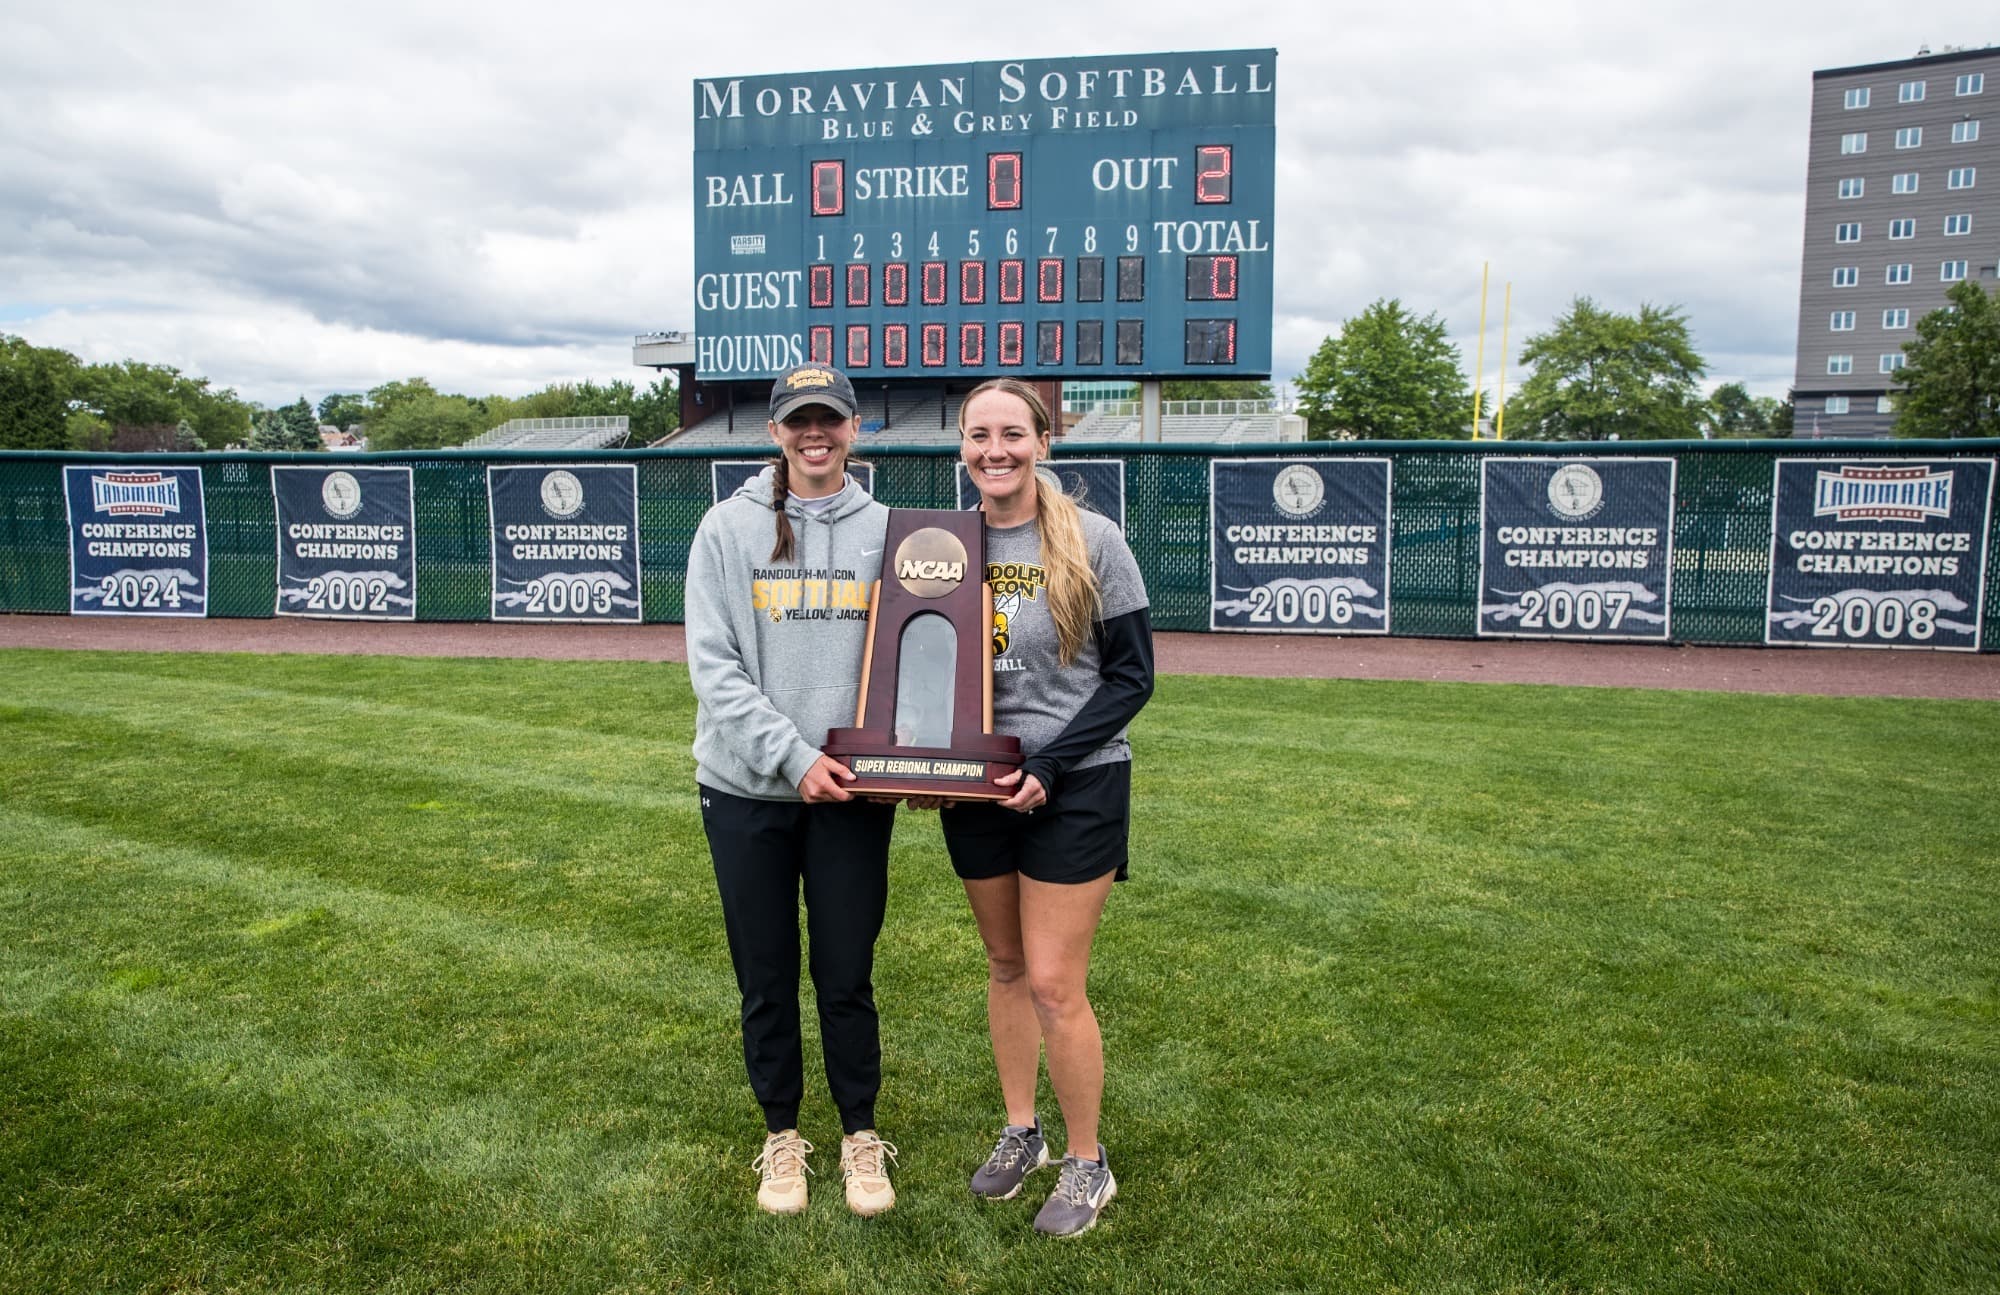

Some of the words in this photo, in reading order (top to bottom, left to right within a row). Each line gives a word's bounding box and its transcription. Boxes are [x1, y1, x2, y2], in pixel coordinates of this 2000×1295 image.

[699, 78, 965, 119] MORAVIAN
[1000, 63, 1272, 103] SOFTBALL
[822, 118, 893, 139] BLUE
[911, 112, 933, 135] &
[954, 110, 1032, 133] GREY
[1051, 107, 1138, 129] FIELD
[706, 173, 793, 207] BALL
[812, 161, 843, 214] 0
[855, 165, 969, 200] STRIKE
[989, 154, 1020, 208] 0
[1092, 157, 1178, 191] OUT
[1198, 146, 1230, 202] 2
[733, 236, 764, 246] VARSITY
[818, 235, 826, 260] 1
[853, 234, 864, 259] 2
[891, 232, 902, 258] 3
[928, 231, 940, 256] 4
[968, 230, 980, 256] 5
[1006, 228, 1018, 255] 6
[1046, 227, 1058, 253] 7
[1084, 226, 1096, 252] 8
[1126, 225, 1138, 252] 9
[1154, 220, 1268, 253] TOTAL
[697, 271, 801, 310] GUEST
[811, 265, 832, 307] 0
[848, 264, 870, 305] 0
[885, 263, 907, 305] 0
[923, 262, 946, 304] 0
[961, 261, 984, 303] 0
[1000, 260, 1022, 302] 0
[1040, 260, 1062, 301] 0
[1212, 256, 1236, 299] 0
[697, 333, 804, 373] HOUNDS
[848, 326, 869, 366] 0
[885, 325, 907, 366] 0
[922, 324, 945, 366] 0
[961, 323, 984, 365] 0
[1000, 323, 1022, 365] 0
[95, 482, 177, 506] LANDMARK
[1819, 479, 1949, 509] LANDMARK
[1843, 509, 1920, 518] CONFERENCE
[82, 523, 197, 540] CONFERENCE
[289, 524, 404, 541] CONFERENCE
[505, 524, 627, 541] CONFERENCE
[1226, 525, 1377, 543] CONFERENCE
[1497, 527, 1657, 547] CONFERENCE
[1790, 531, 1970, 551] CONFERENCE
[88, 543, 192, 558] CHAMPIONS
[295, 543, 398, 560] CHAMPIONS
[512, 544, 622, 561] CHAMPIONS
[1233, 547, 1369, 565] CHAMPIONS
[1504, 549, 1649, 569] CHAMPIONS
[900, 559, 964, 582] NCAA
[1797, 554, 1959, 575] CHAMPIONS
[101, 576, 182, 607] 2024
[307, 578, 388, 611] 2002
[525, 579, 612, 614] 2003
[752, 581, 874, 609] SOFTBAL
[1249, 586, 1353, 625] 2006
[1519, 590, 1631, 630] 2007
[1811, 597, 1937, 640] 2008
[855, 759, 885, 773] SUPER
[886, 761, 931, 774] REGIONAL
[933, 762, 983, 776] CHAMPION
